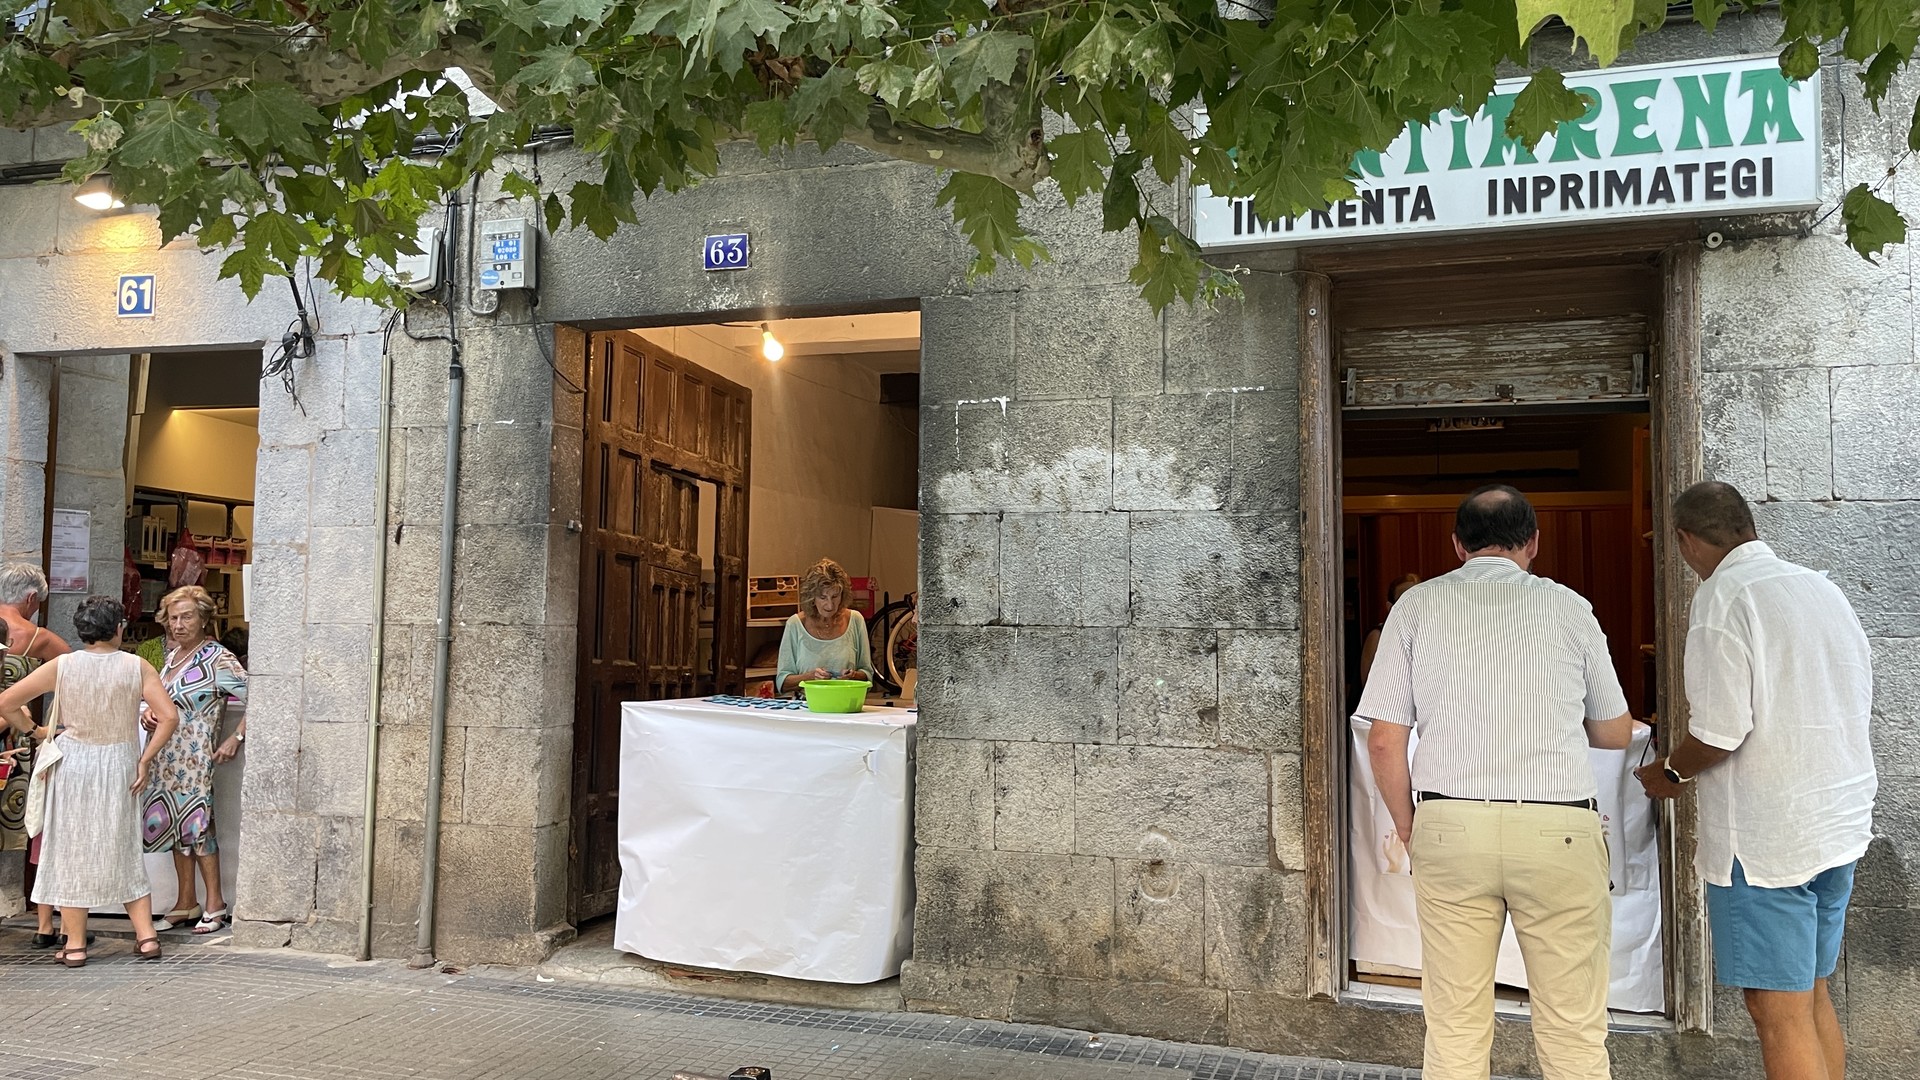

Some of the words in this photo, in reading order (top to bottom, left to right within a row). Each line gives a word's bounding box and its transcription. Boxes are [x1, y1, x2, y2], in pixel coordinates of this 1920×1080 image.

[1487, 156, 1773, 215] INPRIMATEGI
[710, 238, 743, 265] 63
[121, 279, 152, 311] 61
